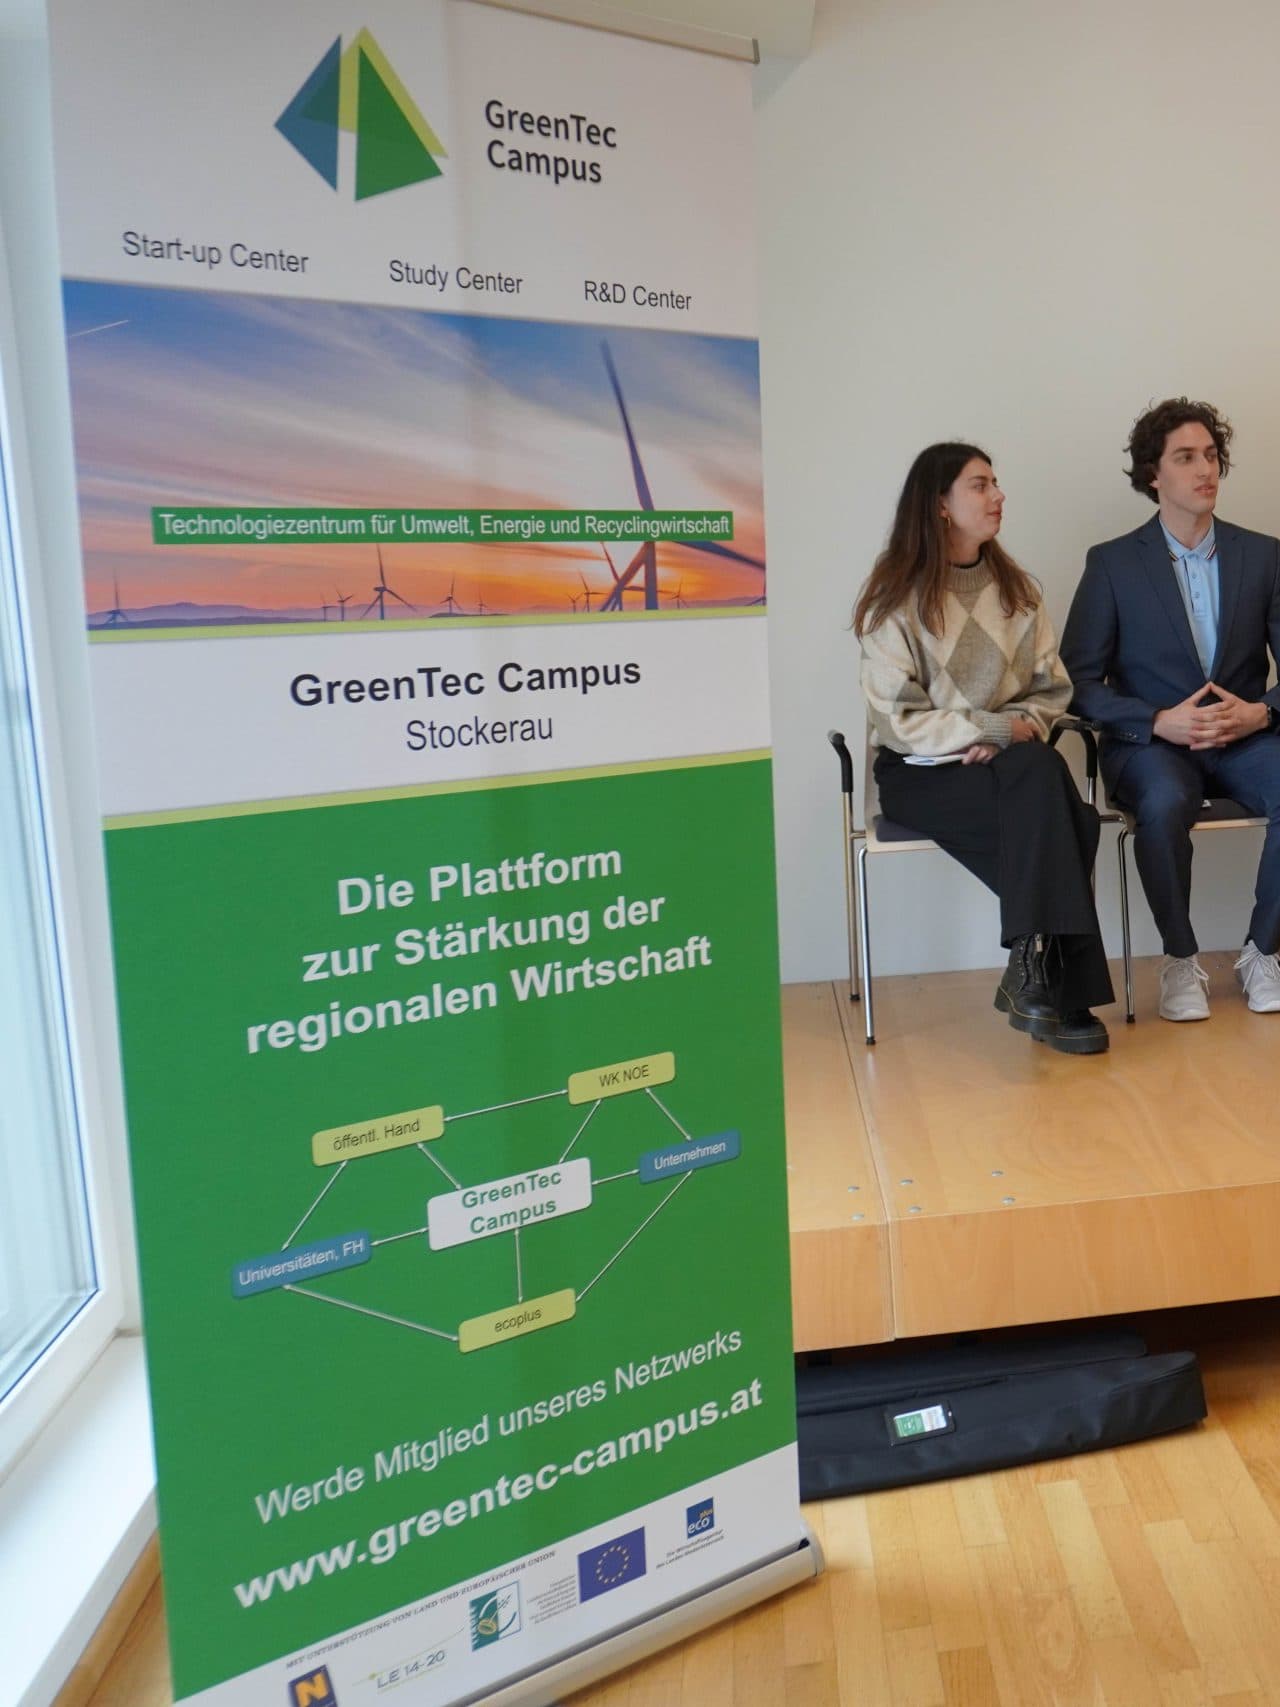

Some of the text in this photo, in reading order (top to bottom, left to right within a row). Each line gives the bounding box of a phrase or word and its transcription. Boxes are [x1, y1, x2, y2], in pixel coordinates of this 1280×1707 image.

[485, 100, 617, 148] GreenTec
[487, 140, 602, 184] Campus
[122, 231, 309, 273] Start-up Center
[389, 260, 523, 294] Study Center
[584, 280, 692, 310] R&D Center
[160, 512, 730, 540] Technologiezentrum für Umwelt, Energie und Recyclingwirtschaft
[291, 662, 641, 706] GreenTec Campus
[406, 716, 553, 751] Stockerau
[337, 851, 622, 915] Die Plattform
[302, 895, 665, 982] zur Stärkung der
[246, 935, 712, 1053] regionalen Wirtschaft
[599, 1064, 650, 1088] WK NOE
[332, 1119, 420, 1151] öffentl. Hand
[653, 1141, 727, 1171] Unternehmen
[462, 1171, 562, 1209] GreenTec
[470, 1197, 557, 1234] Campus
[238, 1239, 365, 1287] Universitäten, FH
[494, 1308, 542, 1333] ecoplus
[254, 1329, 742, 1524] Werde Mitglied unseres Netzwerks
[233, 1377, 763, 1609] www.greentec-campus.at
[688, 1518, 710, 1534] eco
[377, 1650, 446, 1689] LE 14-20
